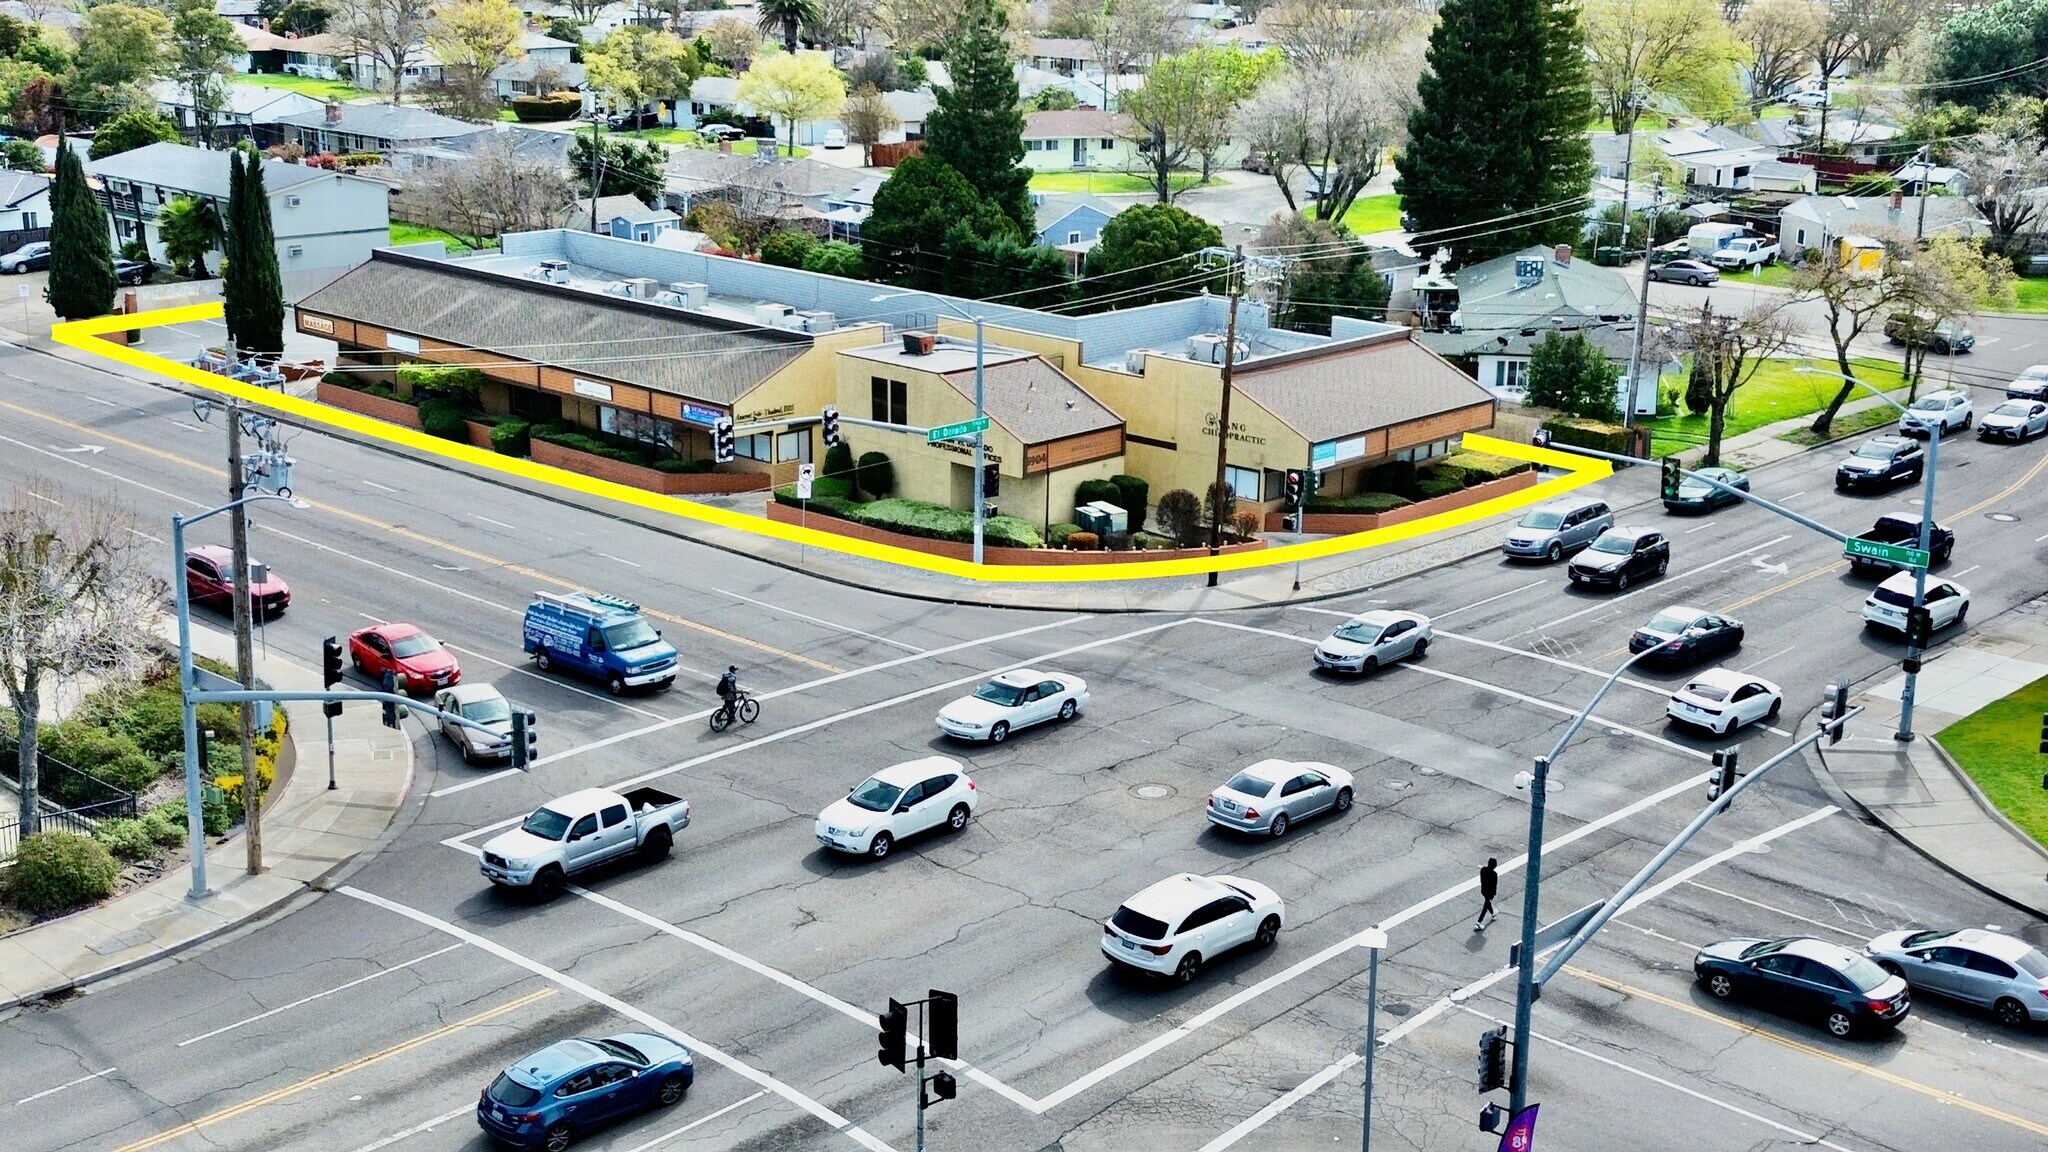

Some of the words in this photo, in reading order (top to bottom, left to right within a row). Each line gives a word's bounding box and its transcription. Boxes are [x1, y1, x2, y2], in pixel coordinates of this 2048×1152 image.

[932, 430, 939, 439] El
[943, 425, 967, 437] Dorado
[1202, 427, 1266, 446] CHIPRACTIC
[1854, 541, 1889, 557] Swain
